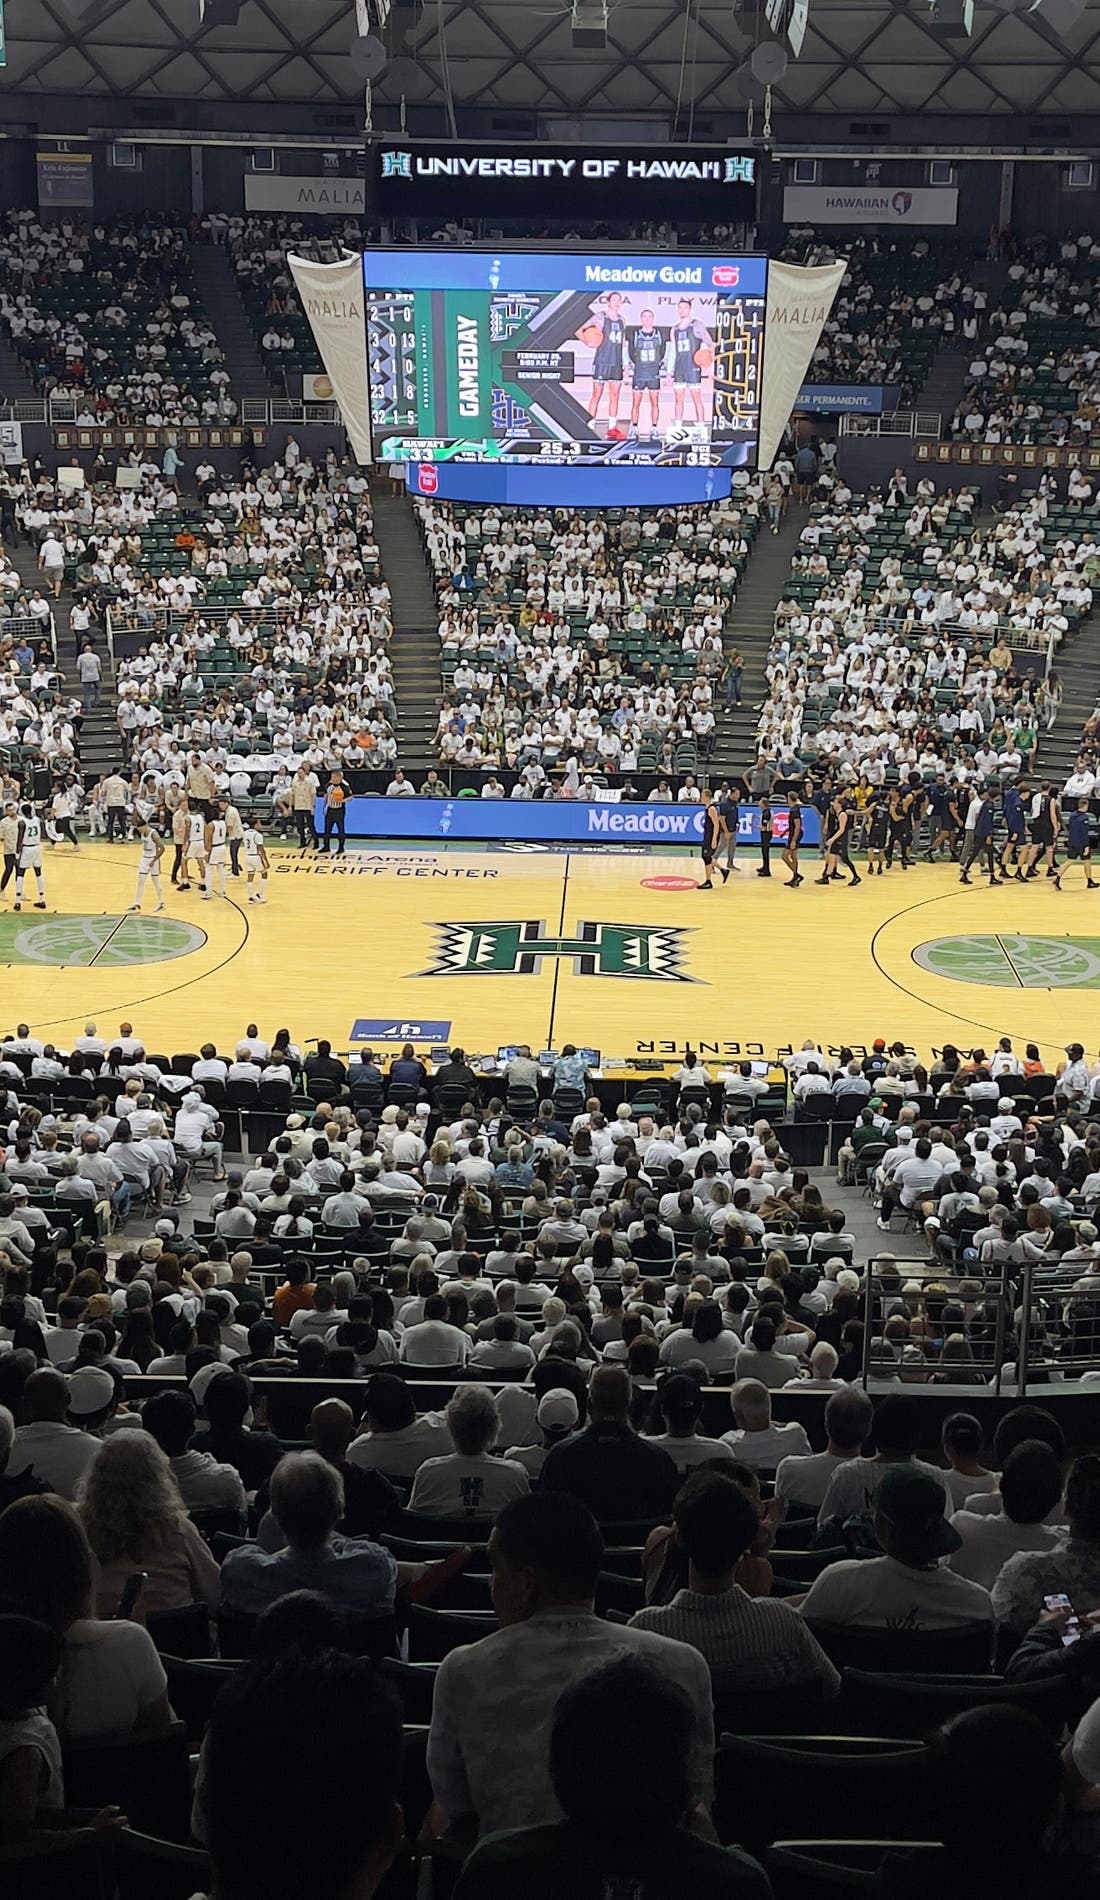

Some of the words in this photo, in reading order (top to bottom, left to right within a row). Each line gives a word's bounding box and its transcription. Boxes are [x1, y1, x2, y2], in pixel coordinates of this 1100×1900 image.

[416, 157, 575, 177] UNIVERSITY
[582, 159, 619, 178] OF
[297, 188, 364, 204] MALIA
[826, 197, 889, 208] HAWAIIAN
[585, 265, 657, 283] Meadow
[660, 266, 702, 283] Gold
[307, 300, 360, 318] MALIA
[370, 306, 378, 321] 2
[389, 306, 395, 321] 1
[403, 306, 411, 322] 0
[771, 307, 825, 324] MALIA
[716, 312, 730, 327] 00
[736, 312, 744, 327] 0
[752, 312, 758, 327] 1
[372, 333, 380, 348] 3
[389, 332, 396, 347] 0
[402, 333, 415, 348] 13
[609, 331, 622, 343] 44
[720, 339, 725, 353] 1
[736, 339, 743, 354] 0
[751, 339, 756, 354] 1
[373, 359, 380, 373] 4
[392, 359, 397, 373] 1
[405, 359, 413, 373] 0
[457, 315, 480, 417] GAMEDAY
[718, 365, 724, 379] 3
[735, 365, 741, 379] 1
[749, 365, 756, 379] 2
[370, 385, 385, 399] 23
[393, 385, 398, 399] 1
[406, 385, 414, 399] 8
[716, 391, 724, 404] 5
[734, 391, 739, 404] 1
[747, 391, 755, 405] 0
[371, 410, 386, 424] 32
[393, 410, 399, 424] 1
[407, 410, 414, 424] 5
[712, 416, 725, 430] 15
[732, 416, 739, 429] 0
[746, 416, 753, 429] 4
[409, 448, 434, 461] 33
[540, 441, 581, 455] 25.3
[686, 453, 712, 466] 35
[588, 809, 690, 833] Meadow
[28, 825, 39, 837] 23
[367, 855, 438, 863] Arena
[274, 864, 388, 875] SHERIFF
[396, 867, 499, 878] CENTER
[636, 1040, 764, 1055] CENTER
